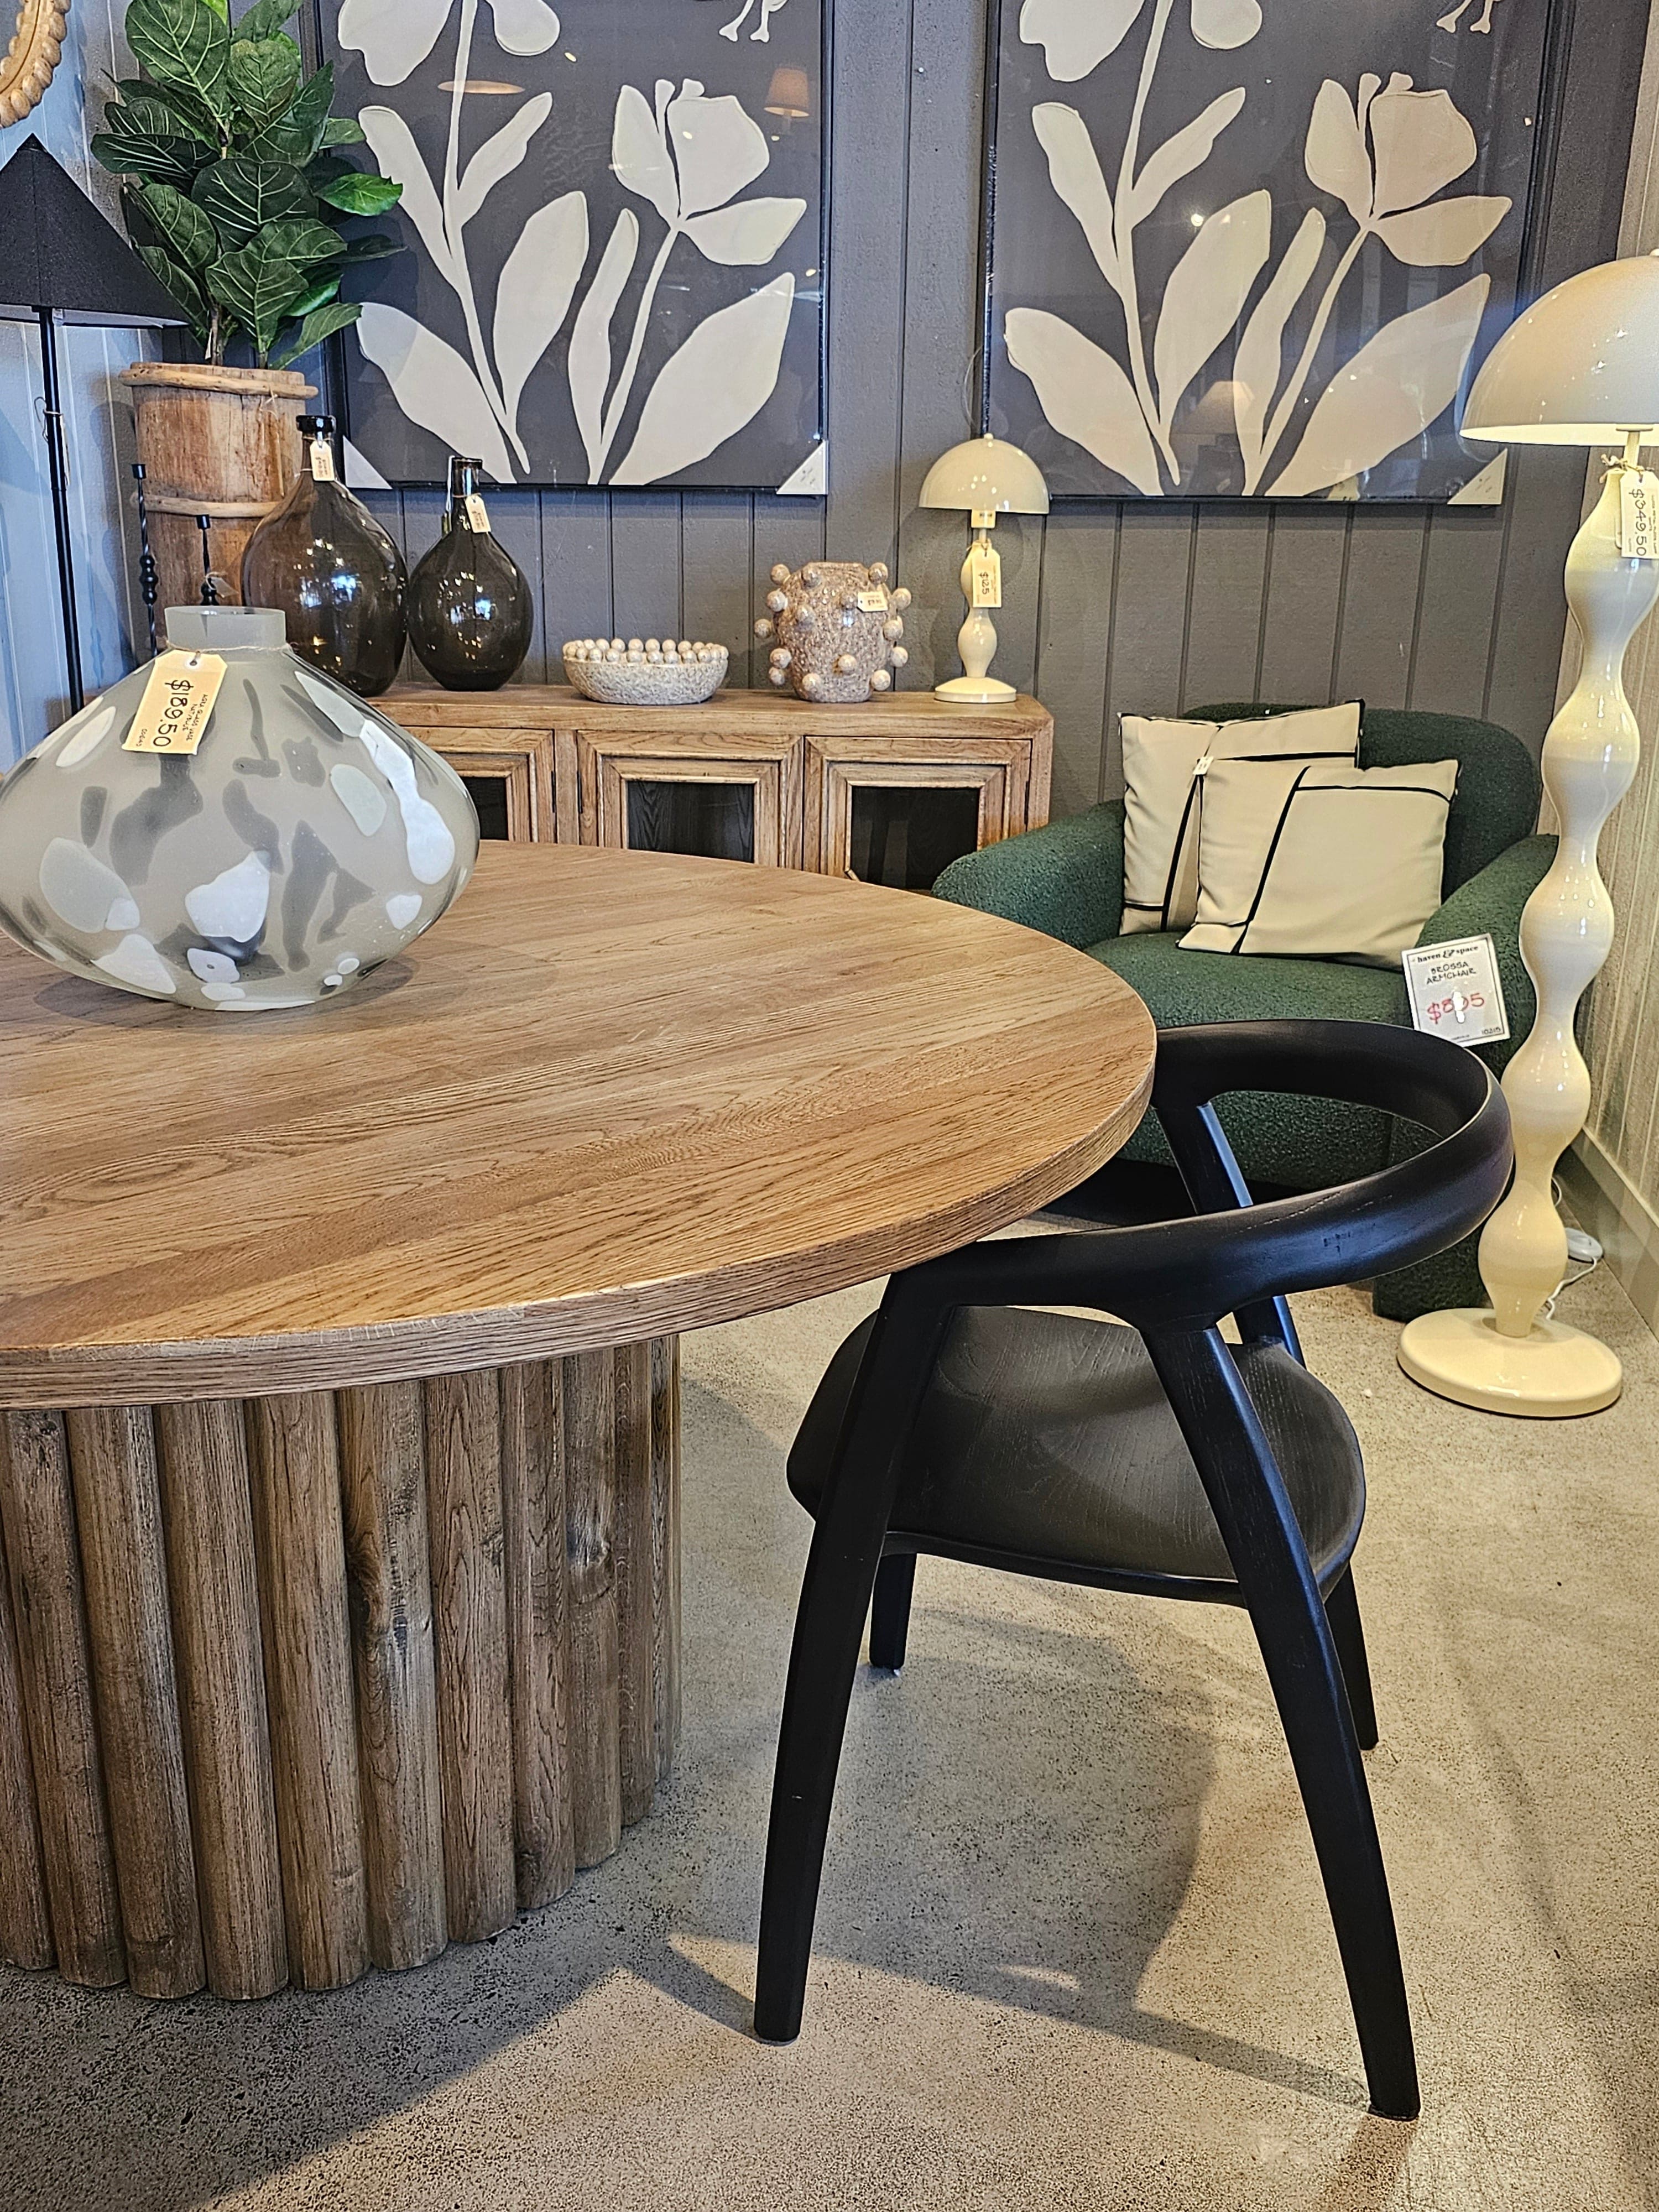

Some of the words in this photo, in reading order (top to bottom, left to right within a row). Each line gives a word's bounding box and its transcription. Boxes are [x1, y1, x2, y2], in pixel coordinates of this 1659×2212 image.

[1629, 488, 1647, 556] $349.50
[978, 571, 990, 595] $125
[153, 679, 194, 747] $189.50
[1417, 954, 1441, 963] haven
[1455, 946, 1479, 956] space
[1426, 968, 1477, 985] ARMCHAIR
